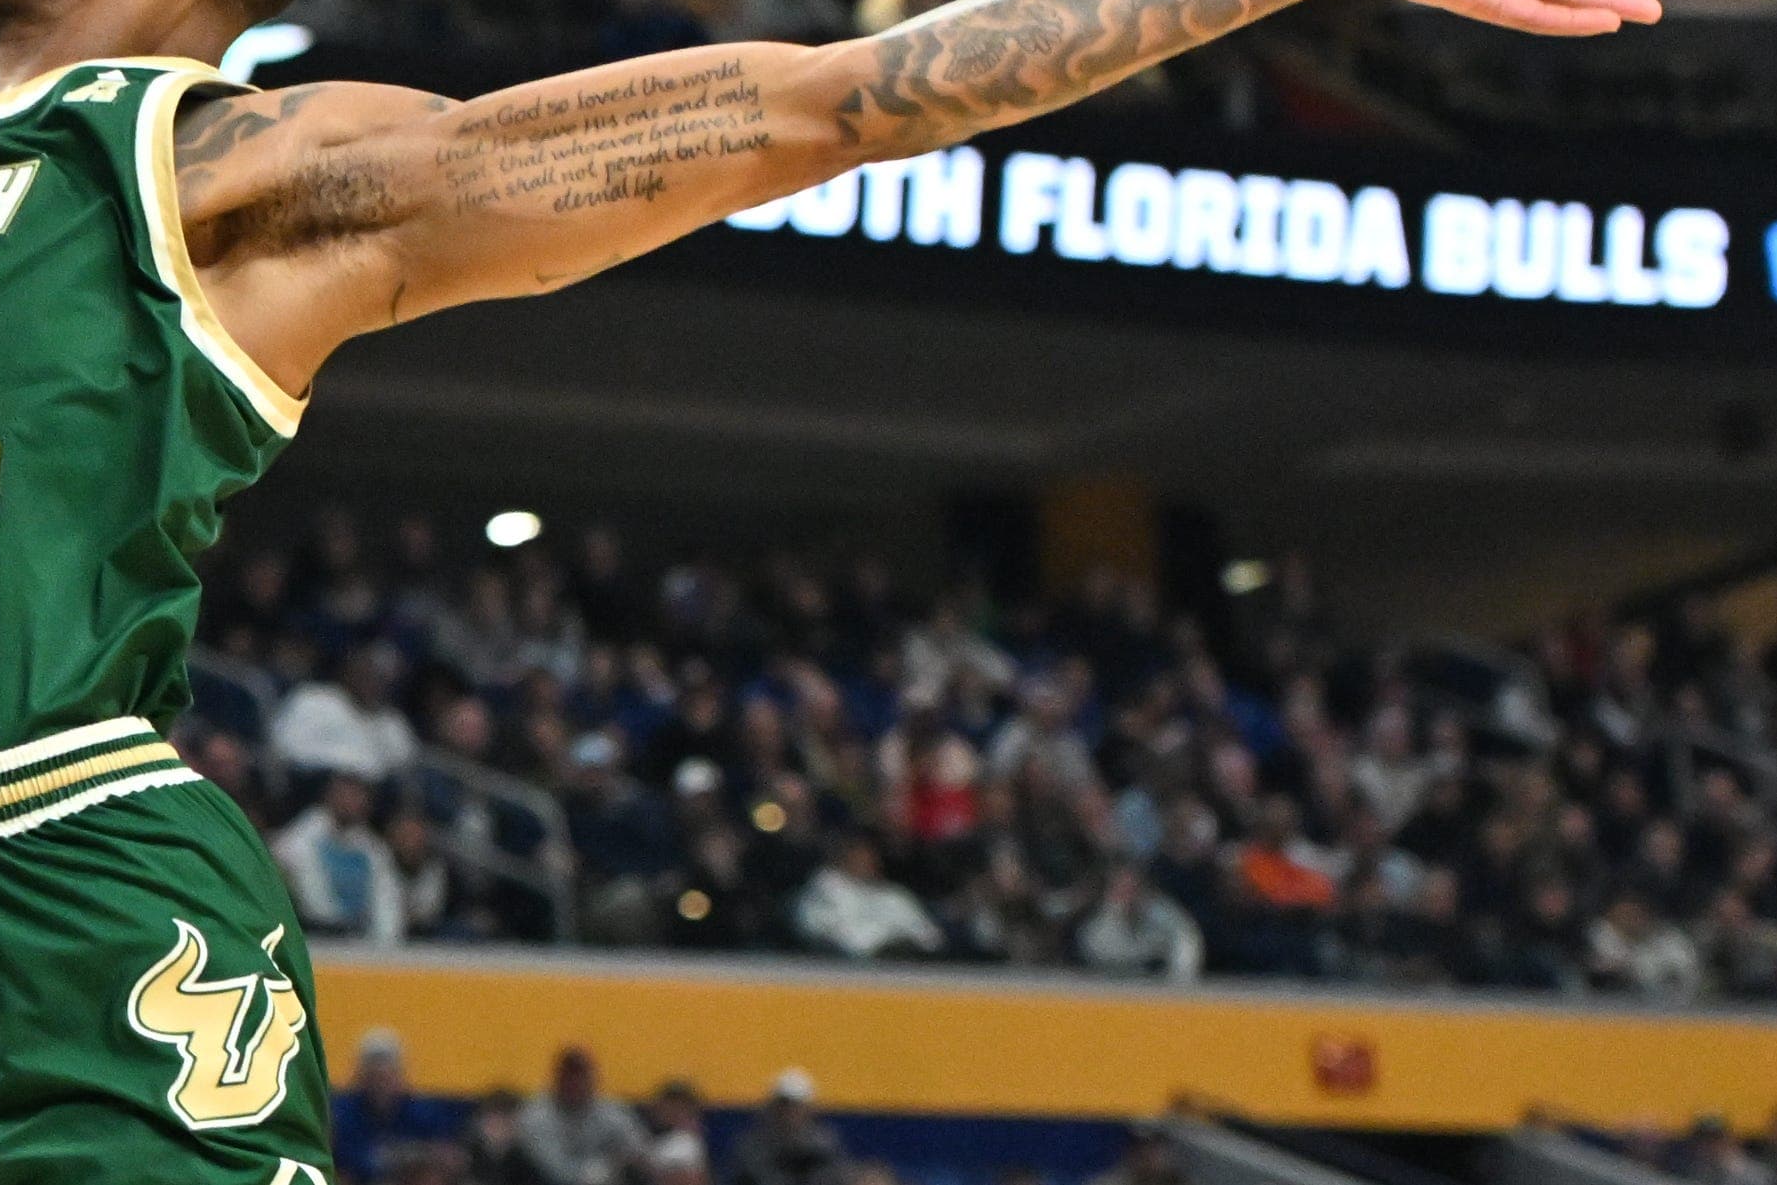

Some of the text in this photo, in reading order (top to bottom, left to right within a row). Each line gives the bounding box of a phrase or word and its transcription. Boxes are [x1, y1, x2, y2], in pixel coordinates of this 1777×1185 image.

[497, 96, 541, 127] God
[546, 98, 569, 116] so
[577, 79, 636, 110] loved
[642, 74, 677, 97] the
[682, 57, 744, 89] world
[668, 88, 708, 115] and
[715, 80, 760, 108] only
[505, 165, 555, 198] shall
[561, 157, 599, 183] not
[604, 142, 673, 185] perish
[676, 133, 712, 161] but
[720, 131, 772, 157] have
[553, 174, 629, 214] eternal
[724, 144, 1731, 310] UTH FLORIDA BULLS
